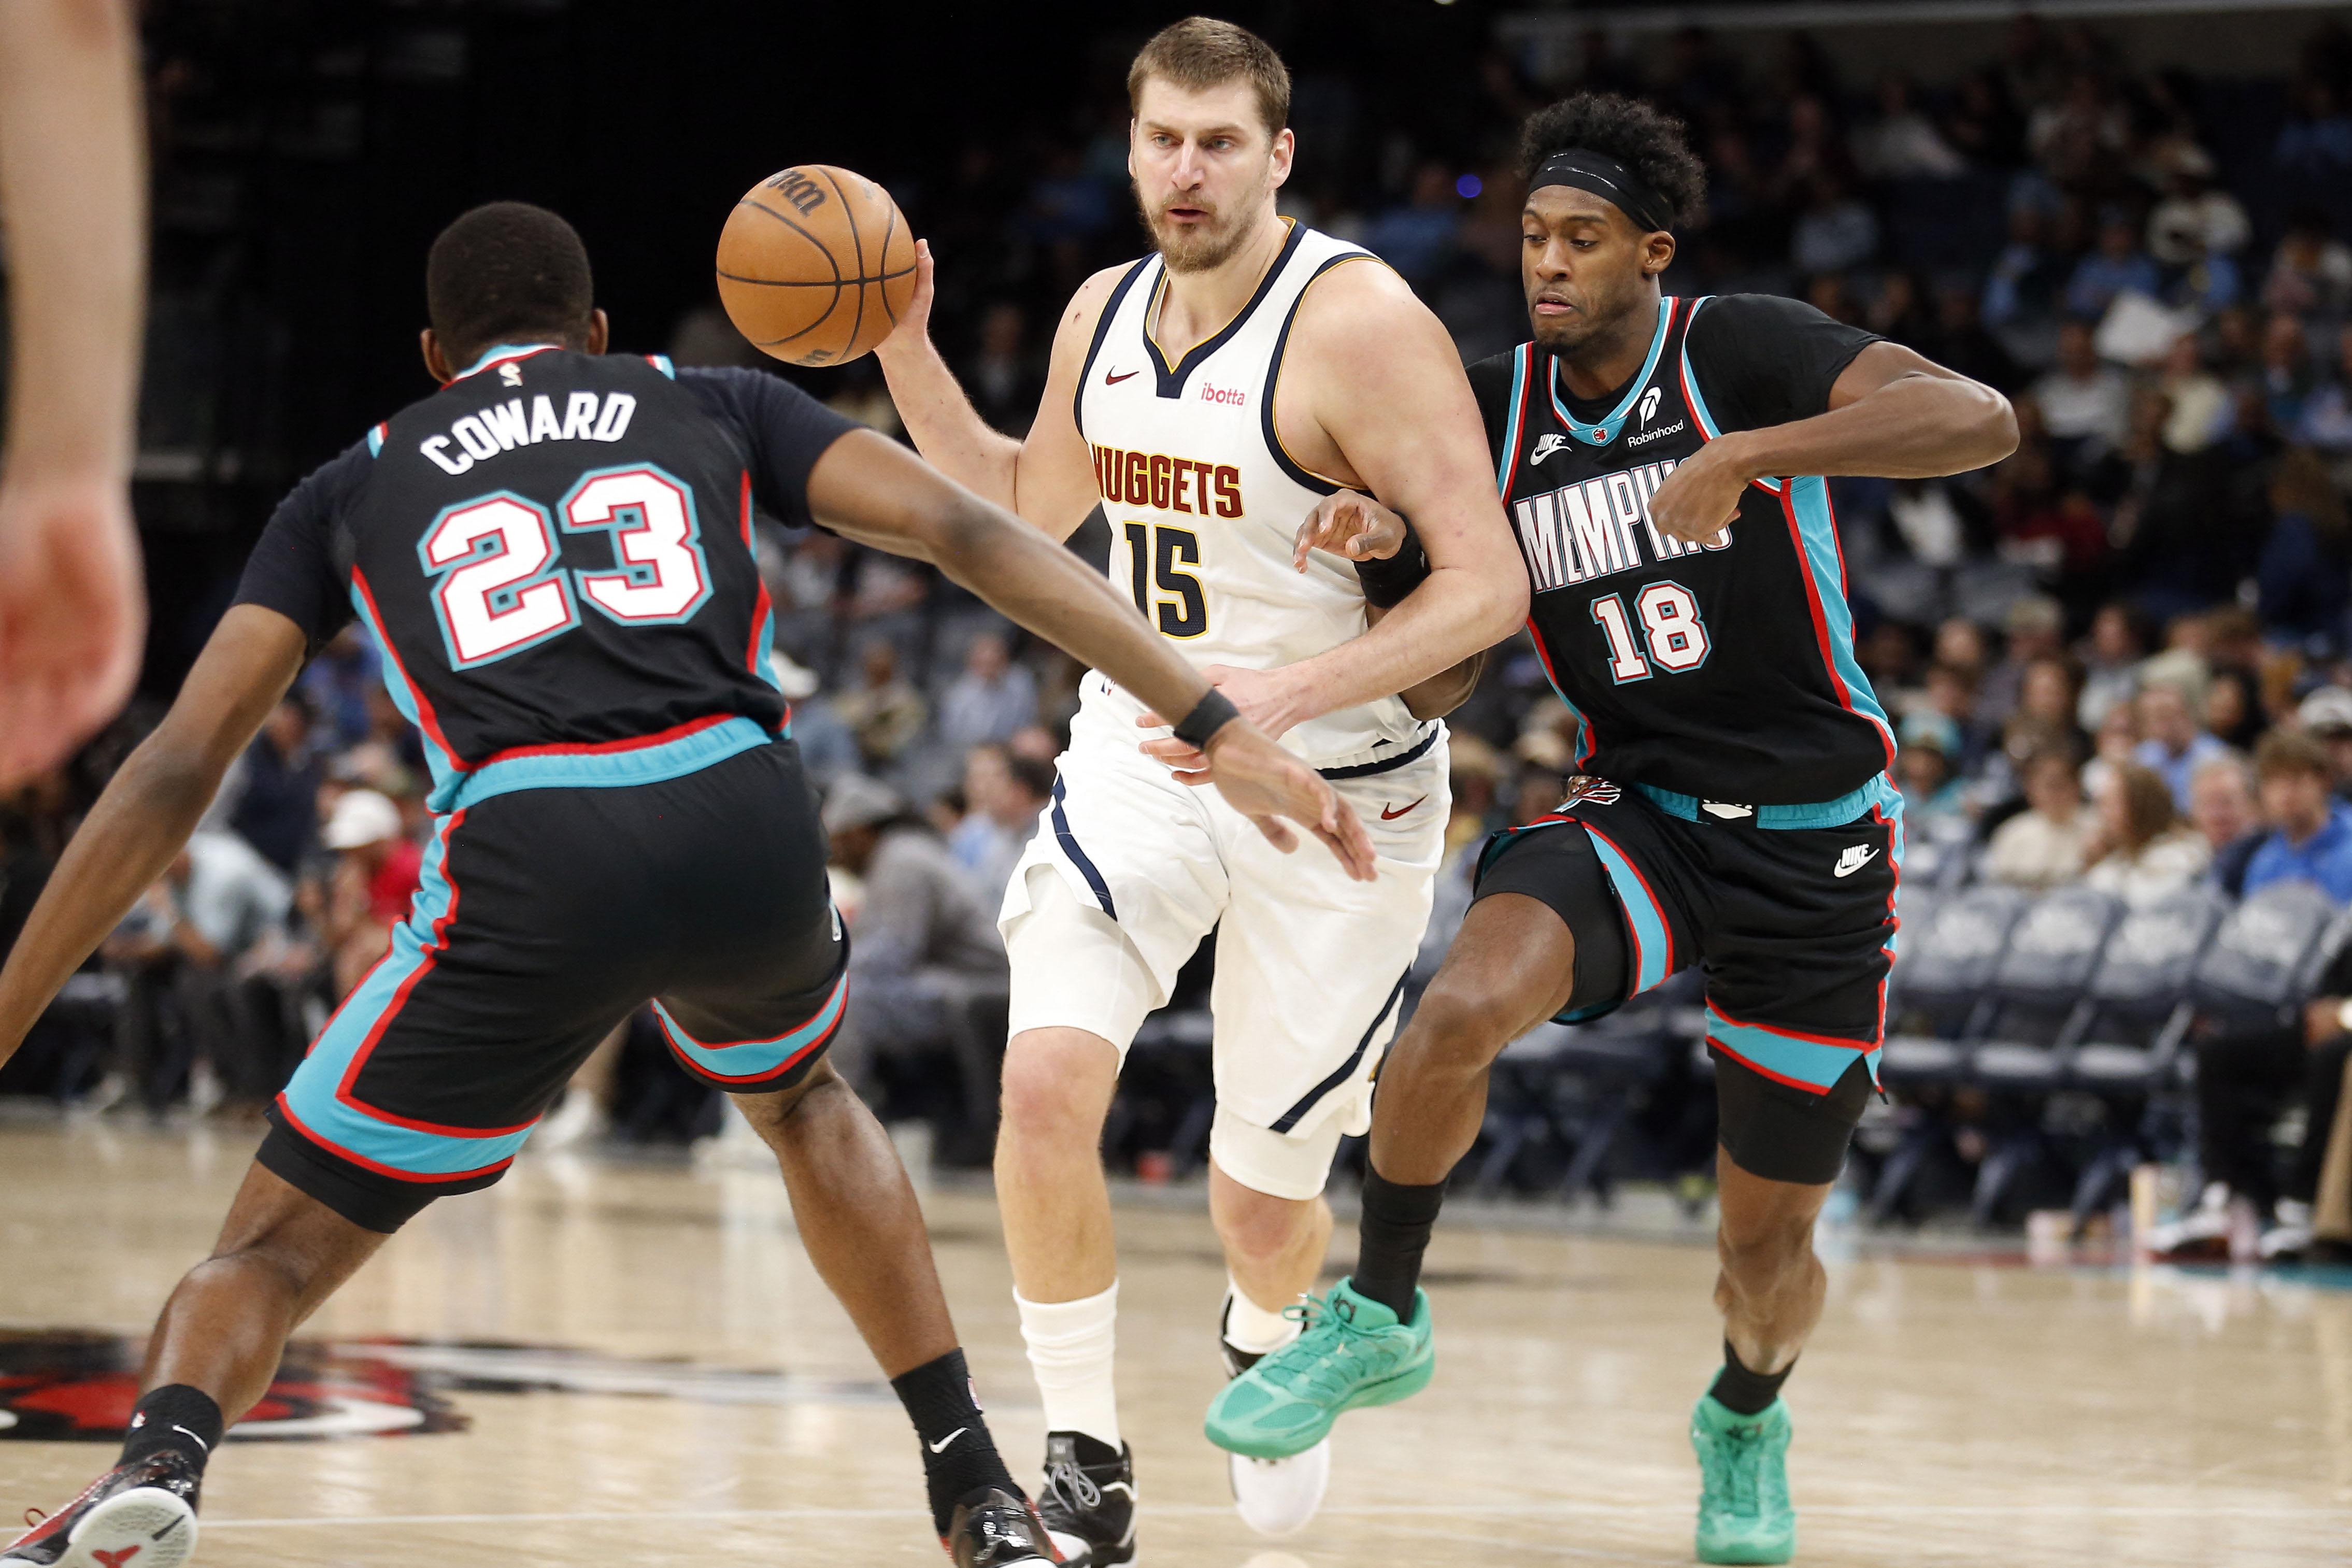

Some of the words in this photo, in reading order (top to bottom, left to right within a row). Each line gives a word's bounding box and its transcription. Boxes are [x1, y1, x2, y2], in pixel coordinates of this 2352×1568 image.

[419, 391, 637, 476] COWARD
[1201, 382, 1245, 406] ibotta
[1627, 419, 1684, 448] Robinhood
[1092, 441, 1246, 520] NUGGETS
[1536, 434, 1566, 452] NIKE
[416, 461, 715, 673] 23
[1123, 520, 1210, 640] 15
[1589, 580, 1712, 685] 18
[1841, 844, 1870, 867] NIKE
